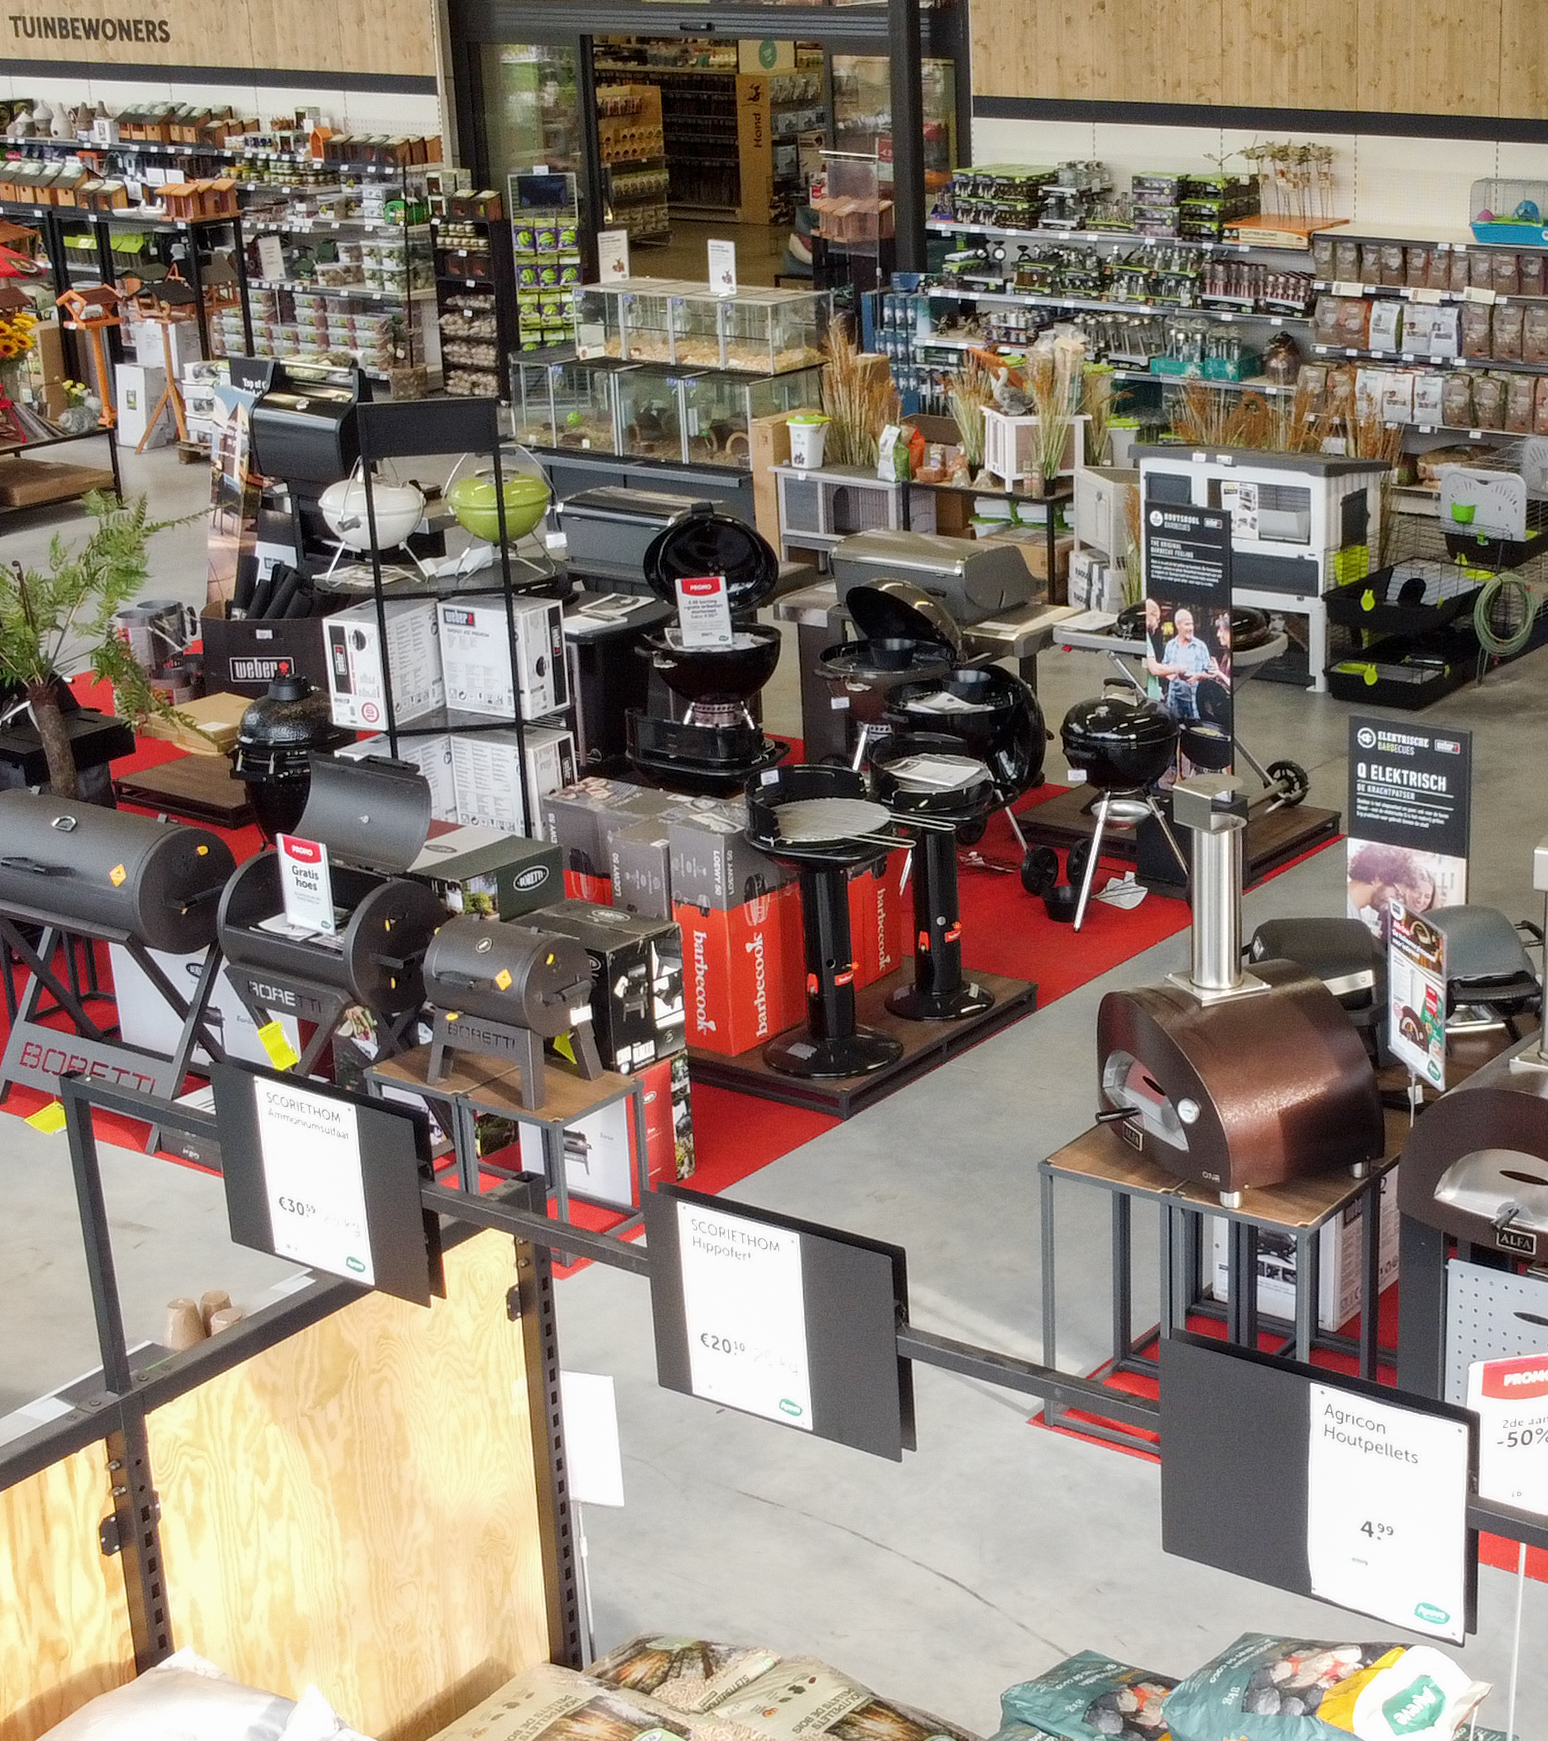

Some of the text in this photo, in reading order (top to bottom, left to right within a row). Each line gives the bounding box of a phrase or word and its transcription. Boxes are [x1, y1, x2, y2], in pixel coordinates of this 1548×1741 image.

[9, 15, 171, 43] TUINBEWONERS
[753, 112, 763, 148] Hond
[444, 608, 468, 624] weber
[235, 660, 278, 680] weber
[1377, 730, 1429, 748] ELEKTRISCHE
[1377, 741, 1415, 756] BARBECUES
[1357, 762, 1447, 792] Q ELEKTRISCH
[1356, 783, 1416, 800] DE KRACHTPATSER
[291, 865, 319, 881] Gratis
[713, 850, 721, 882] LOEWY
[725, 864, 734, 895] LOEWY
[295, 876, 318, 892] hoes
[612, 866, 622, 897] LOEWY
[877, 888, 891, 972] barbecook
[693, 929, 718, 1036] barbecook
[745, 931, 769, 1038] barbecook
[248, 981, 322, 1014] BORETTI
[447, 1022, 517, 1049] BORETTI
[20, 1041, 157, 1095] BORETTI
[266, 1092, 341, 1123] SCORIETHOM
[1202, 1171, 1221, 1184] ONE
[691, 1218, 780, 1252] SCORIETHOM
[692, 1236, 751, 1261] Hippofert
[1501, 1233, 1531, 1250] ALFA
[1324, 1403, 1387, 1435] Agricon
[1502, 1418, 1525, 1429] 2de
[1323, 1425, 1419, 1465] Houtpellets
[1065, 1697, 1085, 1713] 8kg
[1222, 1685, 1241, 1706] 8kg
[1393, 1685, 1437, 1726] Aveve
[791, 1715, 814, 1735] BOIS
